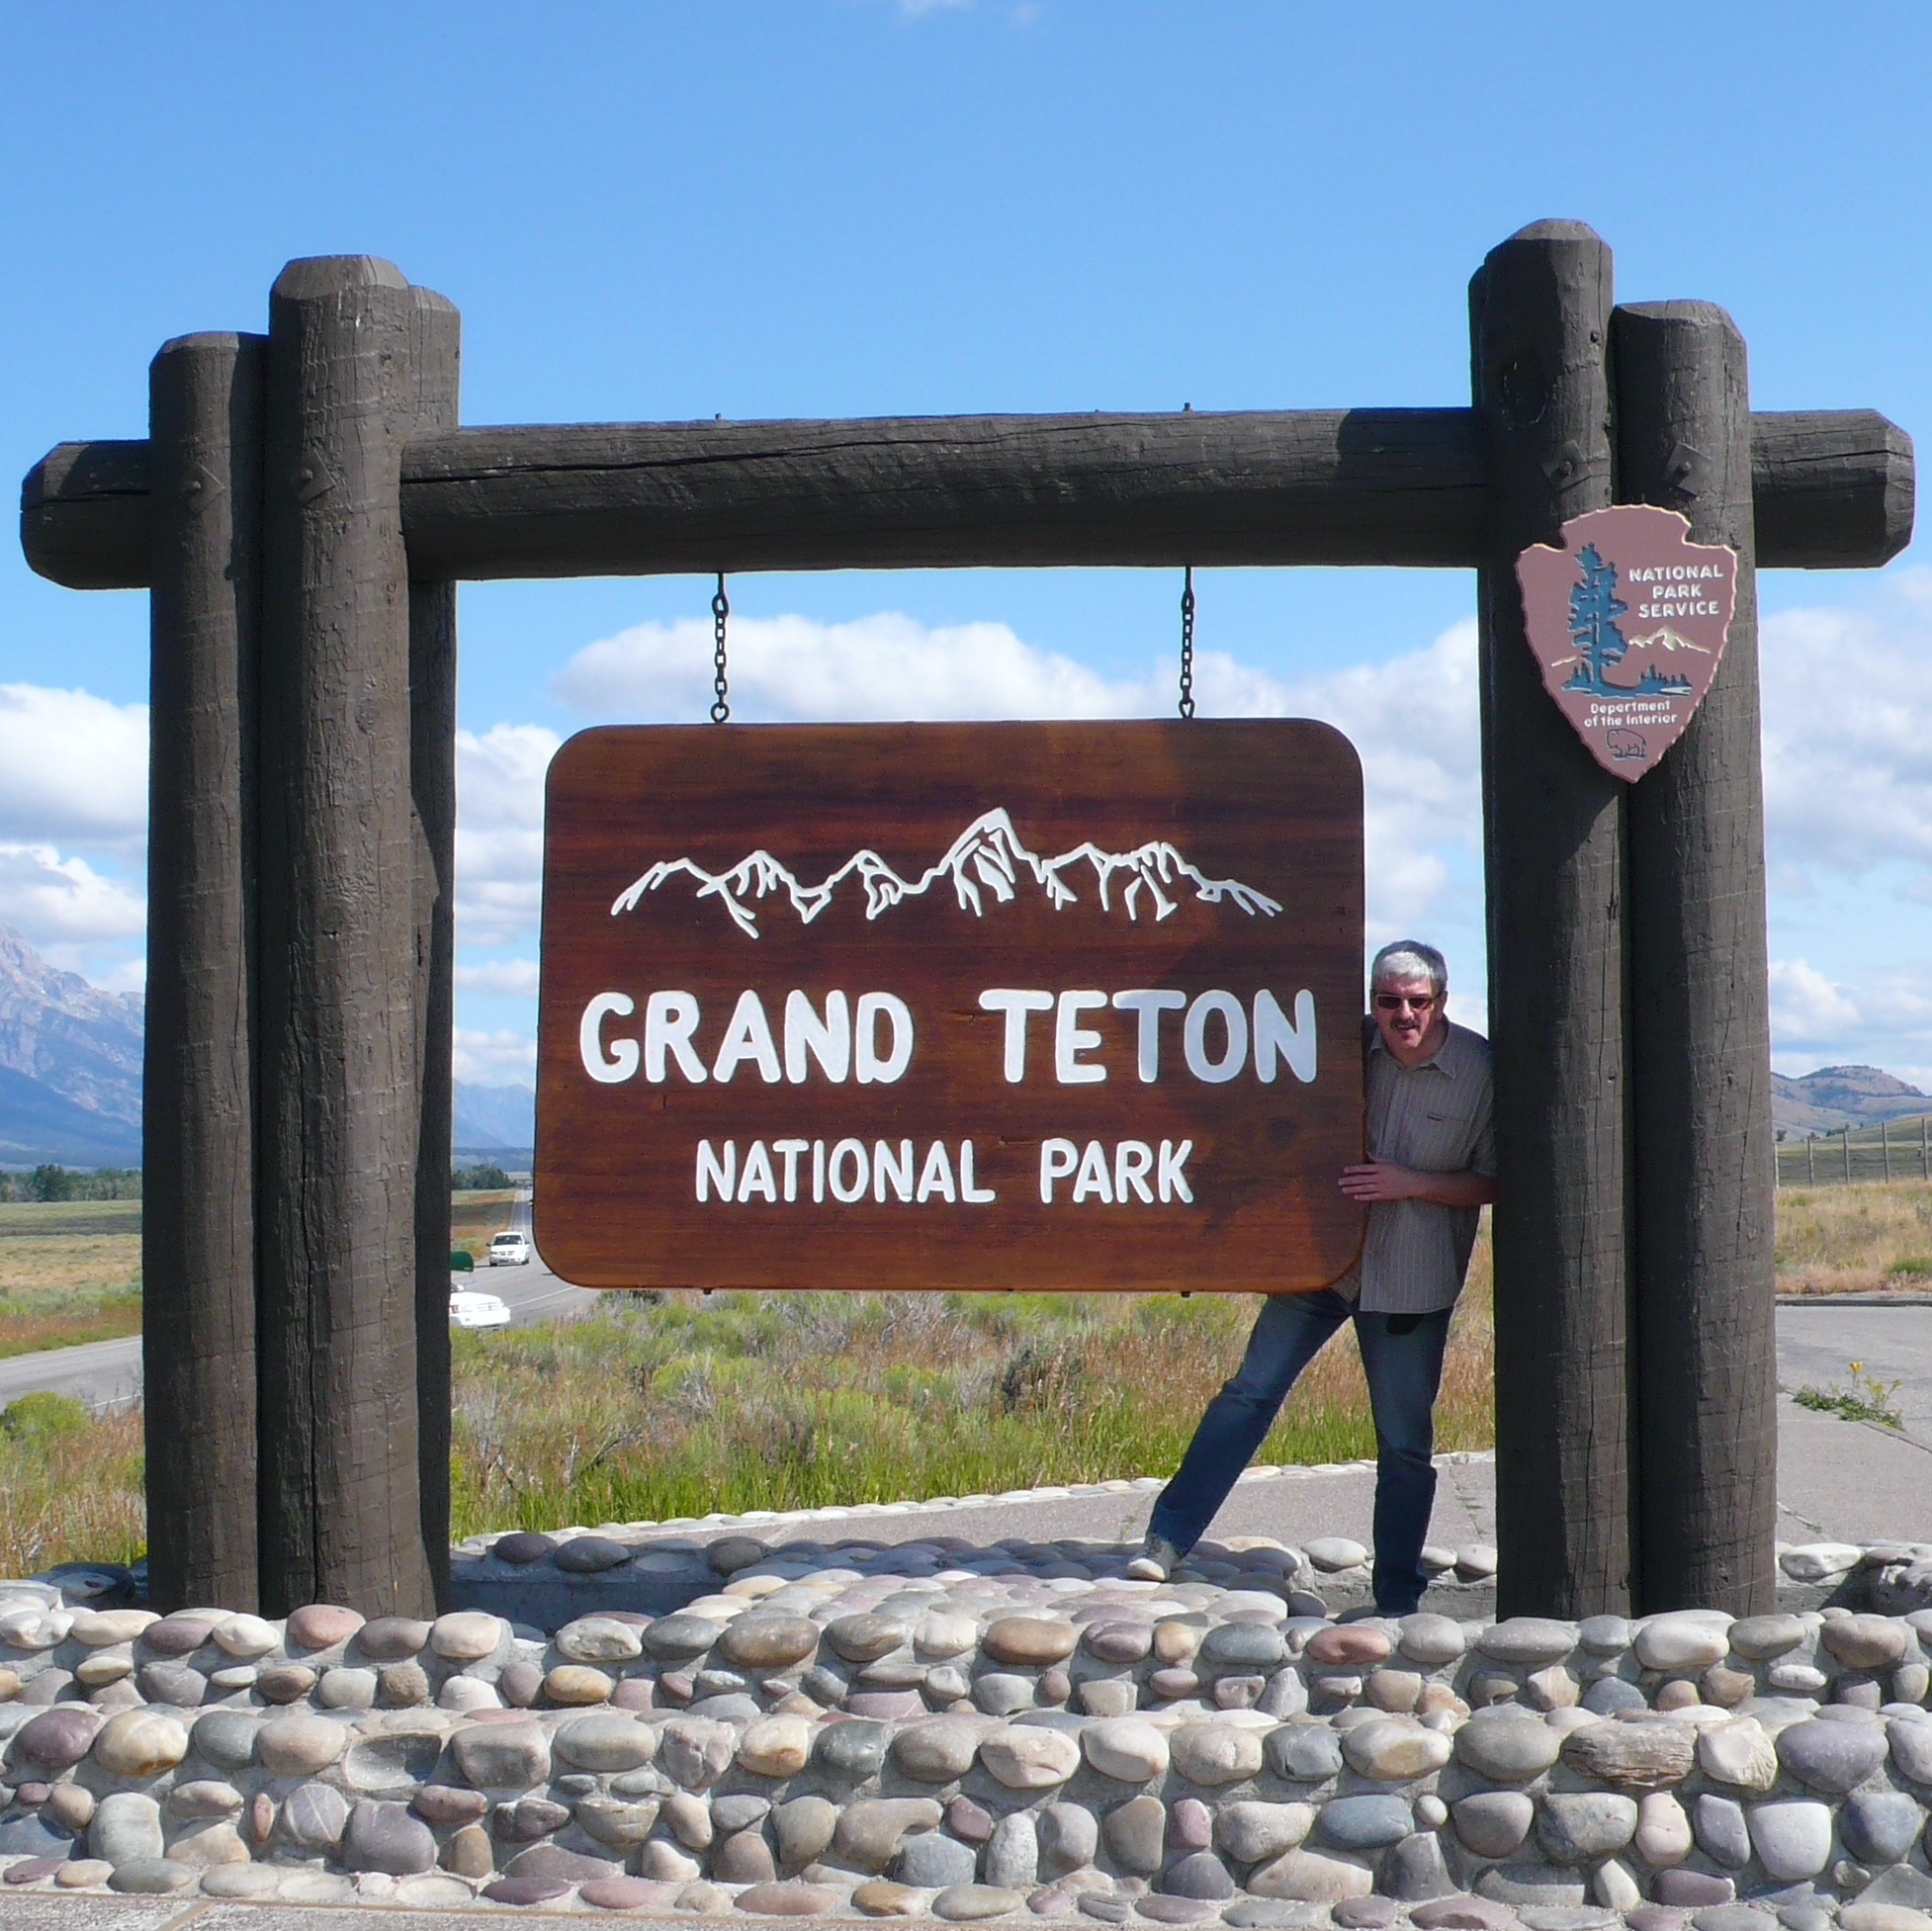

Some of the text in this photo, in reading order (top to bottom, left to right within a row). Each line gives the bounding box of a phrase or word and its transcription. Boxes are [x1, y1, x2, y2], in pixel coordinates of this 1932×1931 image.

[1628, 565, 1723, 582] NATIONAL
[1653, 584, 1703, 599] PARK
[1638, 601, 1719, 619] SERVICE
[1590, 700, 1671, 716] Department
[1584, 713, 1678, 728] of the Interior
[579, 988, 1319, 1085] GRAND TETON
[695, 1137, 1194, 1203] NATIONAL PARK
